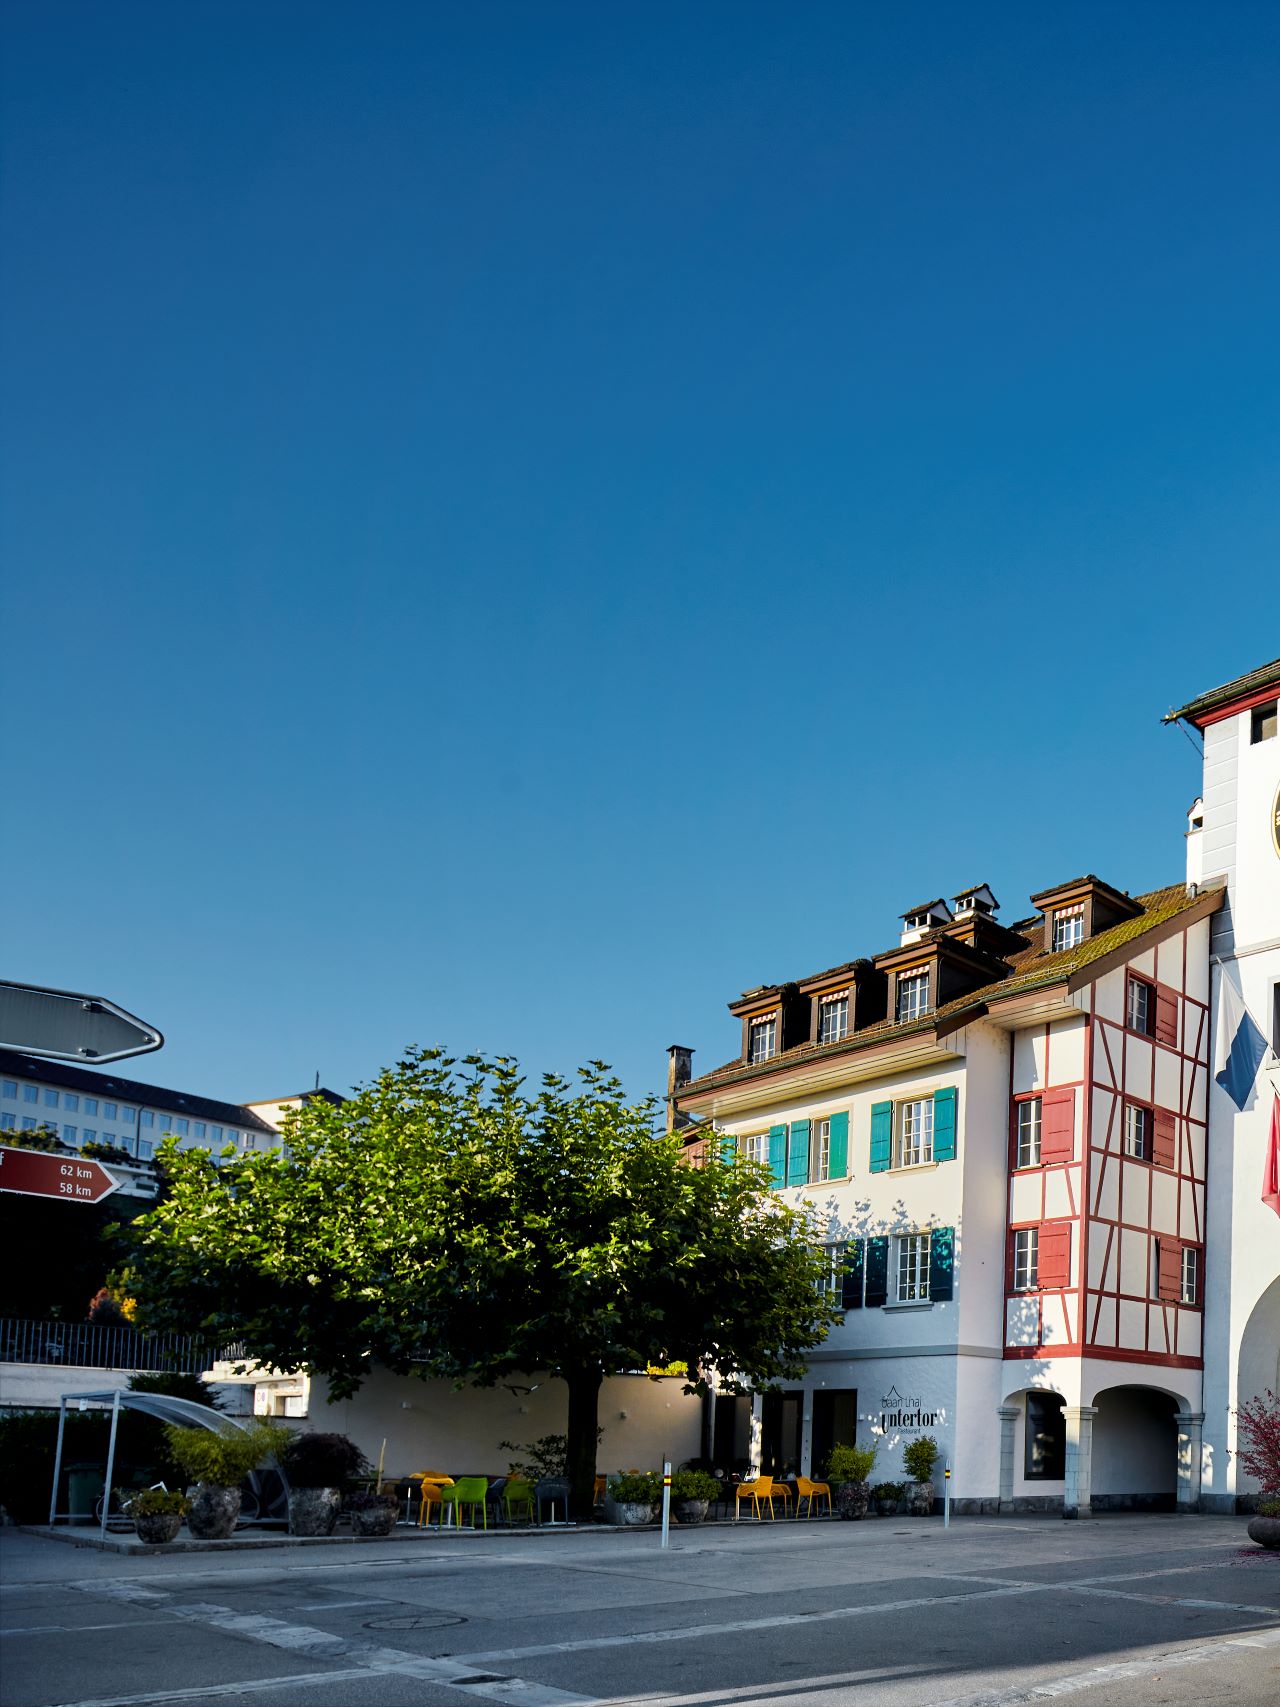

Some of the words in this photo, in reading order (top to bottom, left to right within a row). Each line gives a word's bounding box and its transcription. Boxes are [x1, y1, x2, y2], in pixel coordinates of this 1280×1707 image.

[60, 1165, 73, 1176] 62
[77, 1166, 92, 1179] km
[60, 1182, 73, 1194] 58
[76, 1184, 91, 1196] km
